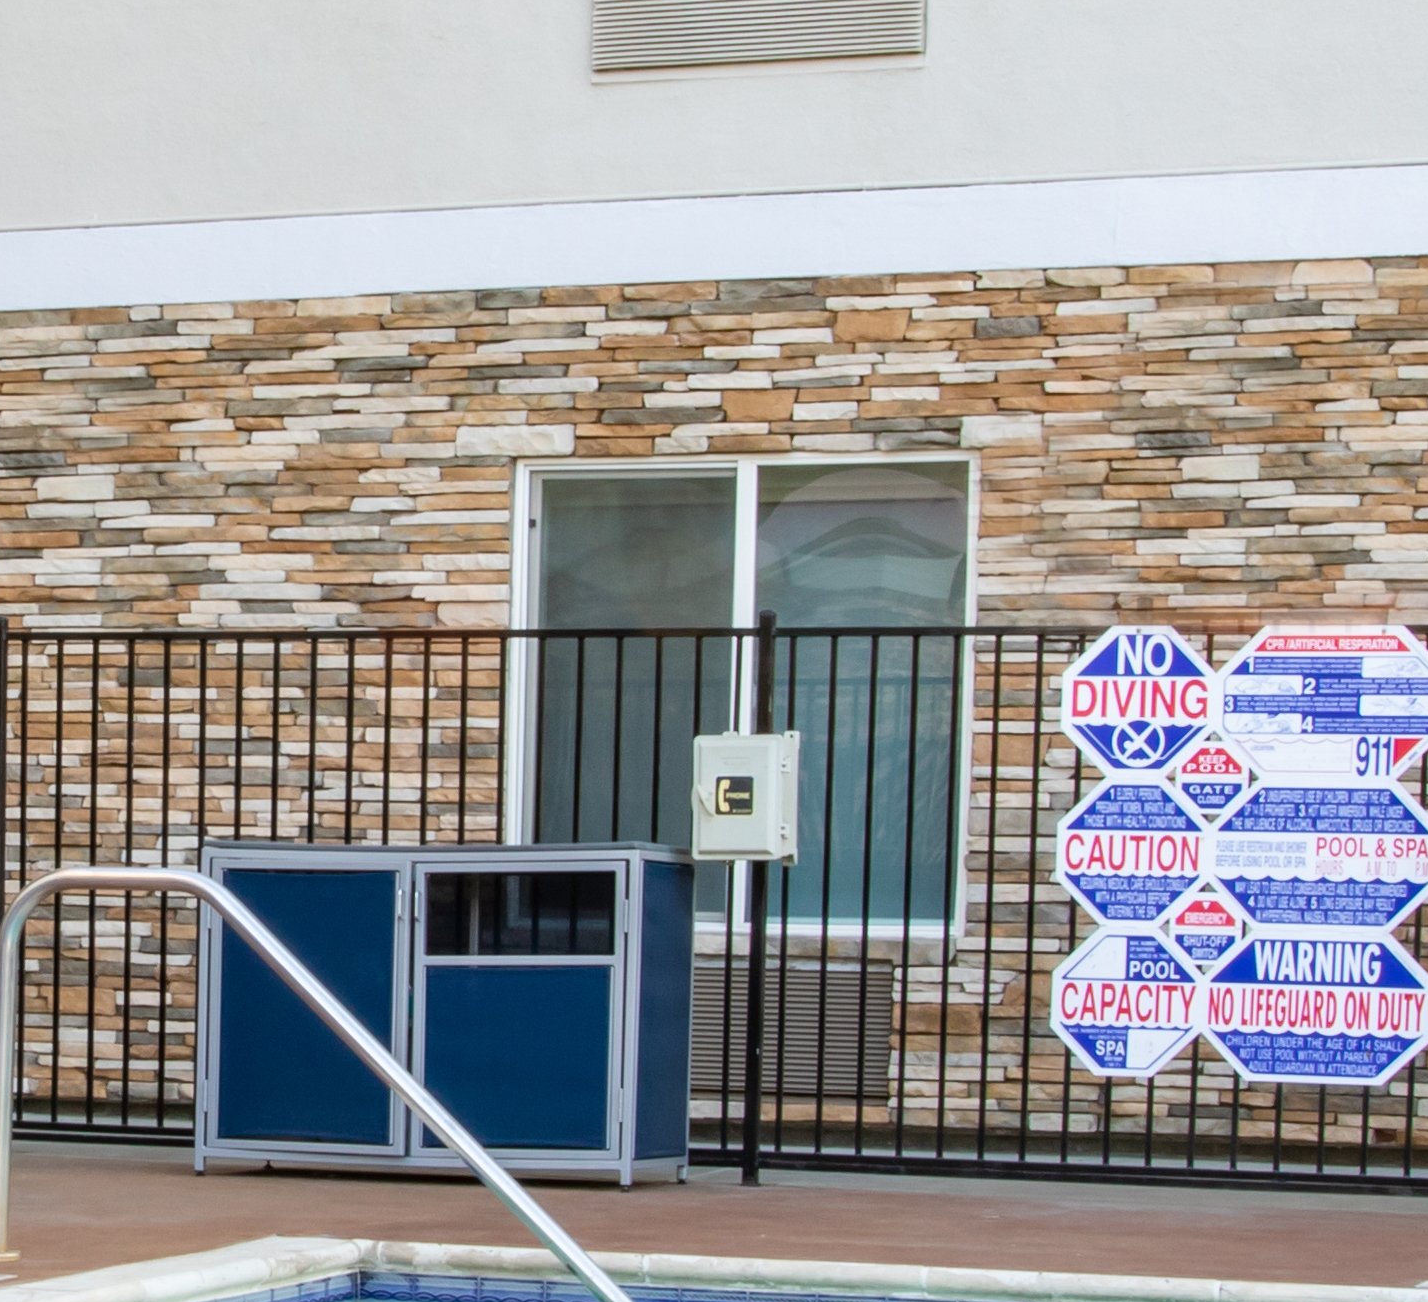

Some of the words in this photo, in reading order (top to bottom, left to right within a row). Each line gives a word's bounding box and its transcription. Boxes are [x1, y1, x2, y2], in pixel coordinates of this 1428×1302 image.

[1339, 639, 1399, 650] RESPIRATION
[1117, 634, 1173, 676] NO
[1304, 678, 1316, 695] 2
[1072, 680, 1208, 719] DIVING
[1224, 697, 1234, 712] 3
[1302, 716, 1313, 733] 4
[1199, 754, 1227, 763] KEEP
[1356, 736, 1391, 776] 911
[1186, 763, 1239, 772] POOL
[1189, 785, 1234, 795] GATE
[1197, 796, 1225, 805] CLOSED
[1065, 834, 1200, 872] CAUTION
[1316, 837, 1369, 857] POOL
[1375, 838, 1387, 858] &
[1393, 838, 1428, 859] SPA
[1315, 860, 1344, 875] HOURS
[1386, 861, 1397, 876] TO
[1184, 912, 1229, 925] EMERGENCY
[1183, 935, 1228, 948] SHUT-OFF
[1192, 947, 1219, 959] SWITCH
[1129, 961, 1181, 980] POOL
[1254, 940, 1381, 985] WARNING
[1061, 982, 1197, 1024] CAPACITY
[1208, 987, 1234, 1026] NO
[1241, 988, 1338, 1029] LIFEGUARD
[1344, 990, 1371, 1030] ON
[1377, 992, 1427, 1032] DUTY
[1095, 1040, 1126, 1056] SPA
[1225, 1035, 1271, 1047] CHILDREN
[1273, 1036, 1304, 1048] UNDER
[1307, 1037, 1323, 1049] THE
[1325, 1038, 1344, 1050] AGE
[1346, 1039, 1358, 1050] OF
[1360, 1040, 1371, 1051] 14
[1374, 1040, 1403, 1053] SHALL
[1239, 1048, 1256, 1060] NOT
[1257, 1048, 1273, 1060] USE
[1275, 1049, 1295, 1060] POOL
[1297, 1050, 1334, 1062] WITHOUT
[1335, 1051, 1342, 1062] A
[1343, 1052, 1374, 1063] PARENT
[1376, 1053, 1388, 1064] OR
[1249, 1061, 1272, 1073] ADULT
[1274, 1062, 1315, 1074] GUARDIAN
[1317, 1063, 1325, 1074] IN
[1327, 1064, 1378, 1076] ATTENDANCE
